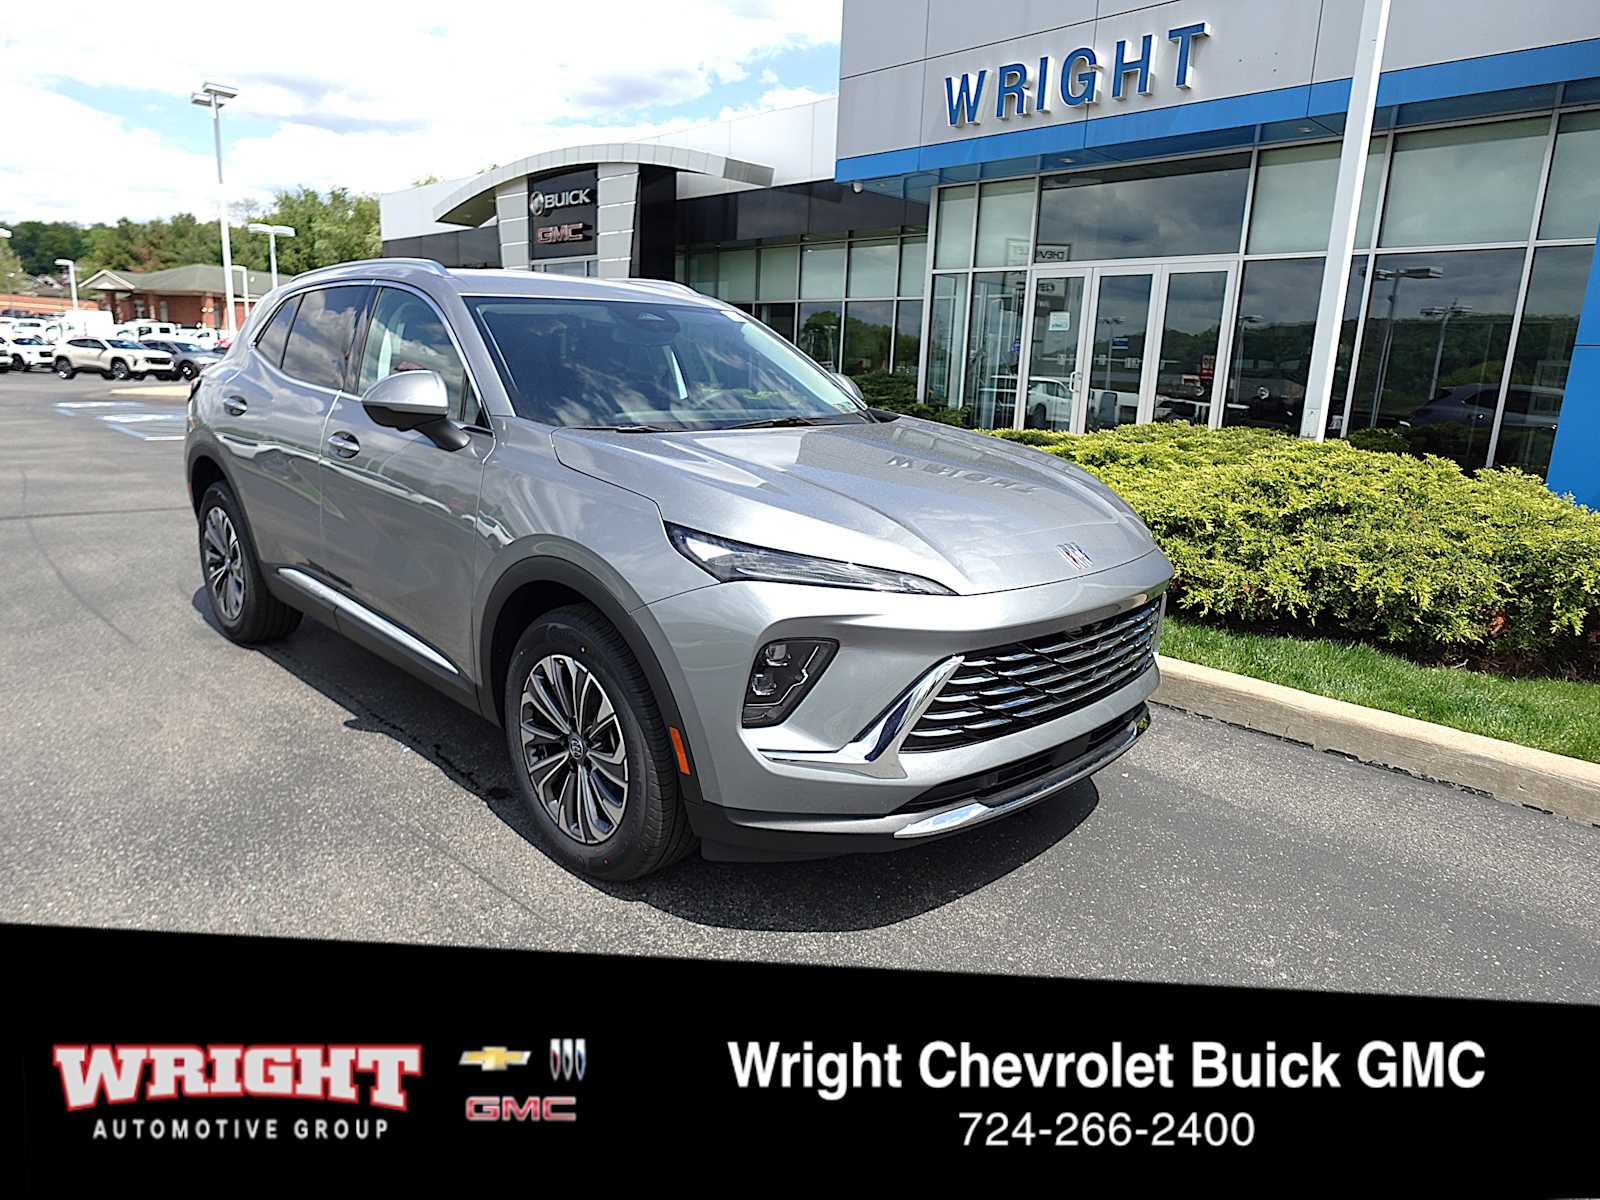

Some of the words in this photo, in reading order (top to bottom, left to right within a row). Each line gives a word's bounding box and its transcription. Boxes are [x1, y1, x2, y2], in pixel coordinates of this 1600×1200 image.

[945, 22, 1211, 127] WRIGHT
[544, 188, 591, 209] BUICK
[537, 223, 583, 244] GMC
